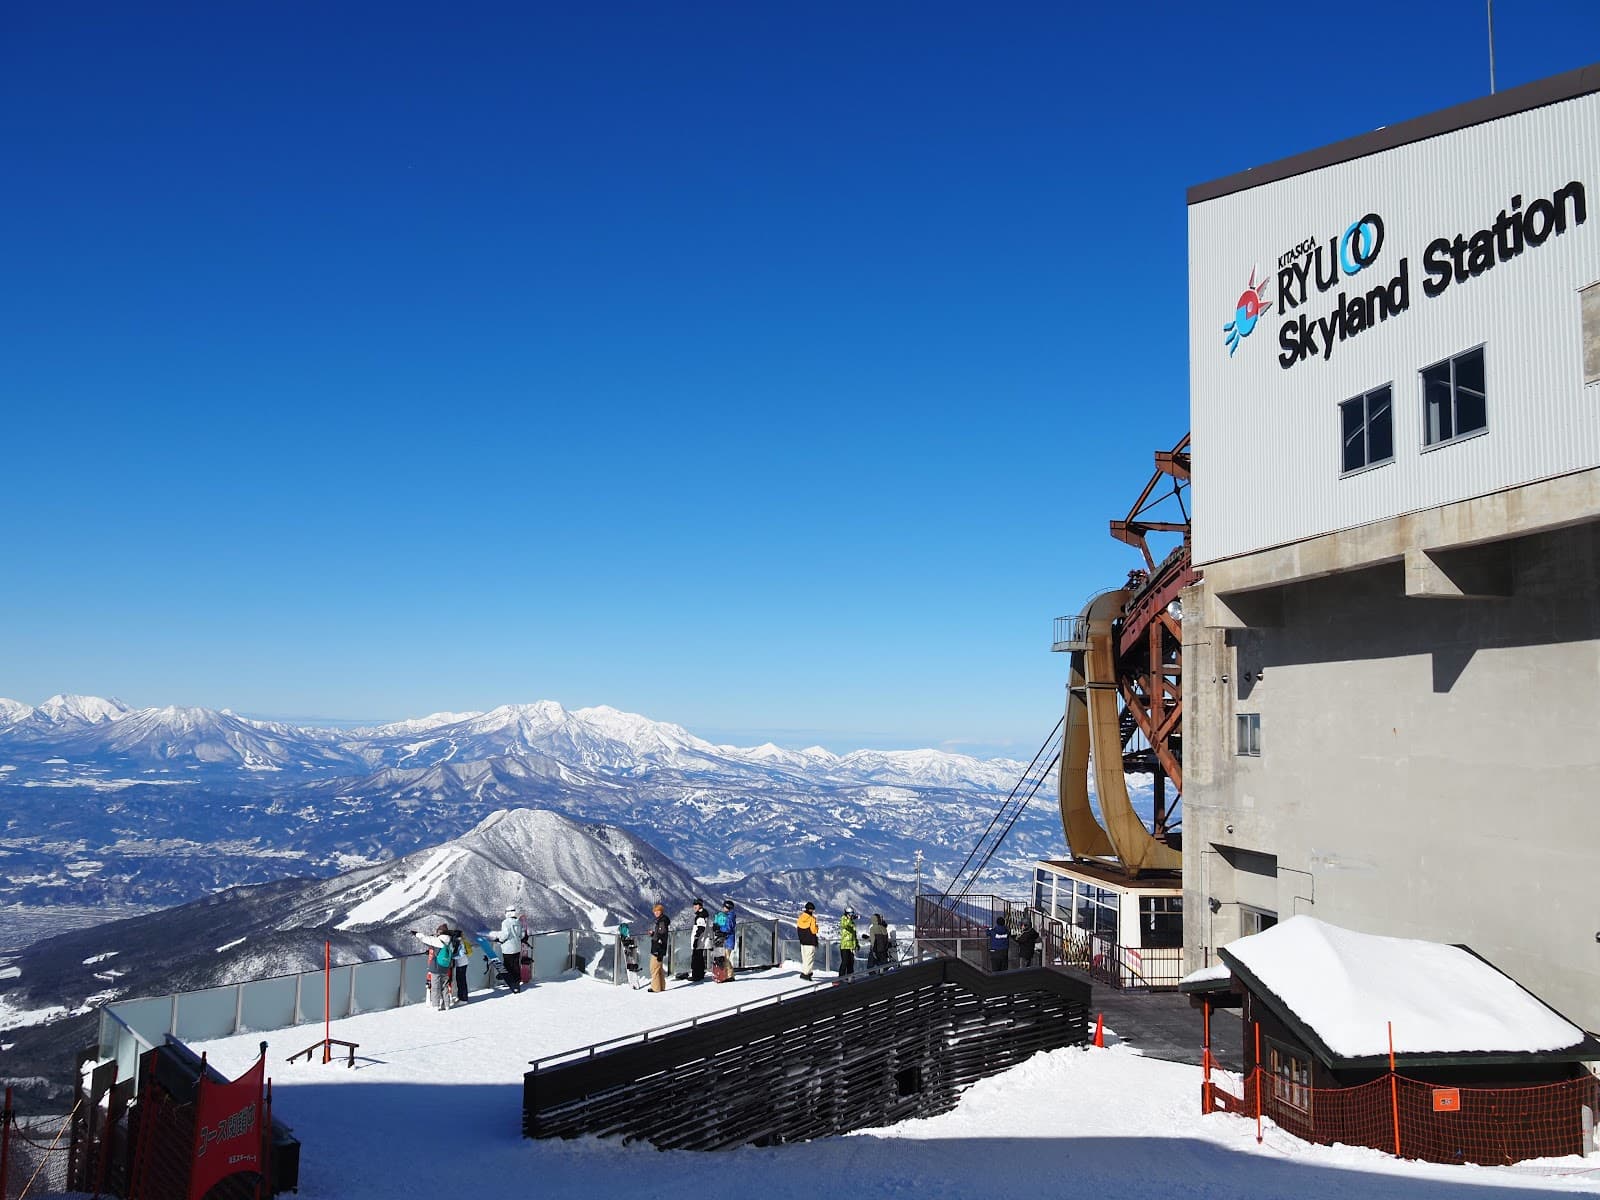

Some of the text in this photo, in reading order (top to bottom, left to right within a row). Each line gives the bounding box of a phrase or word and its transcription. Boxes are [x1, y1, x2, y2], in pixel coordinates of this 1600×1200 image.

[1278, 235, 1316, 270] KITASIGA
[1278, 181, 1587, 370] Skyland Station
